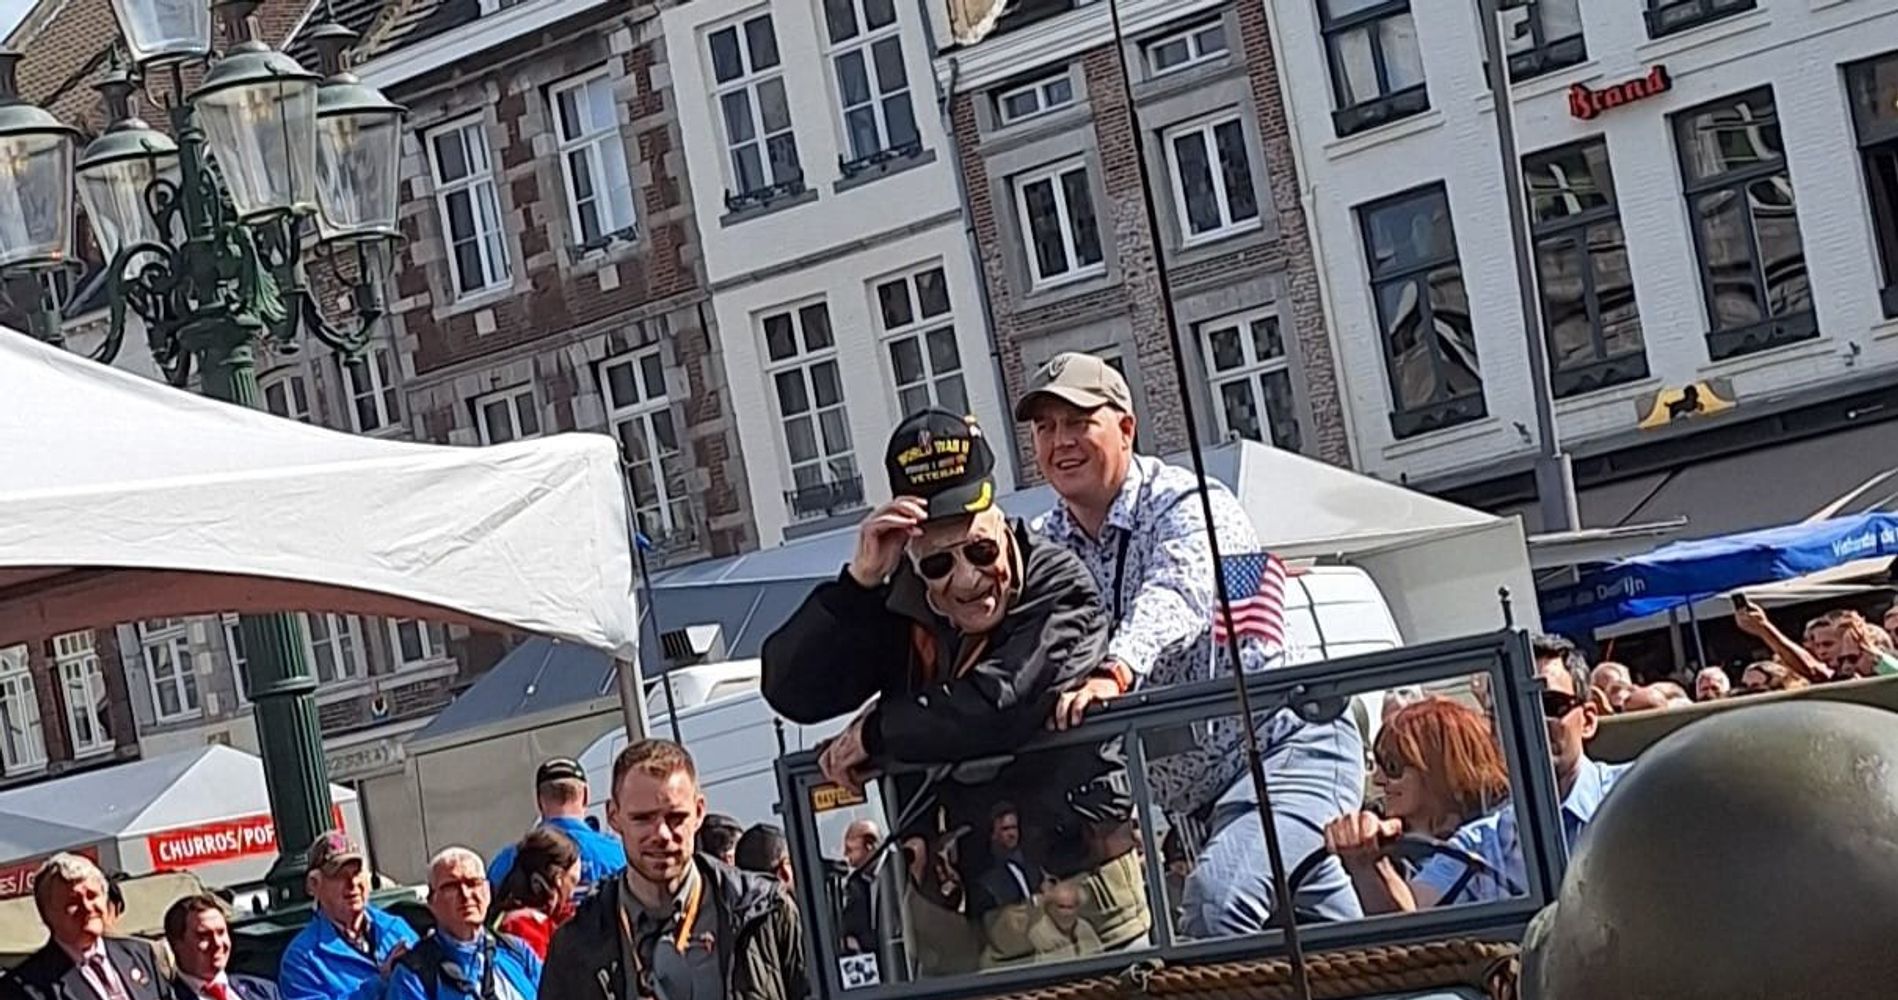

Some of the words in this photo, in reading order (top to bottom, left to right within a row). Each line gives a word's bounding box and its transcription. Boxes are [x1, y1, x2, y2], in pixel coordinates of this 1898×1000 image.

[1569, 65, 1669, 119] Brand
[933, 439, 960, 453] WAR
[909, 465, 965, 484] VETERAN
